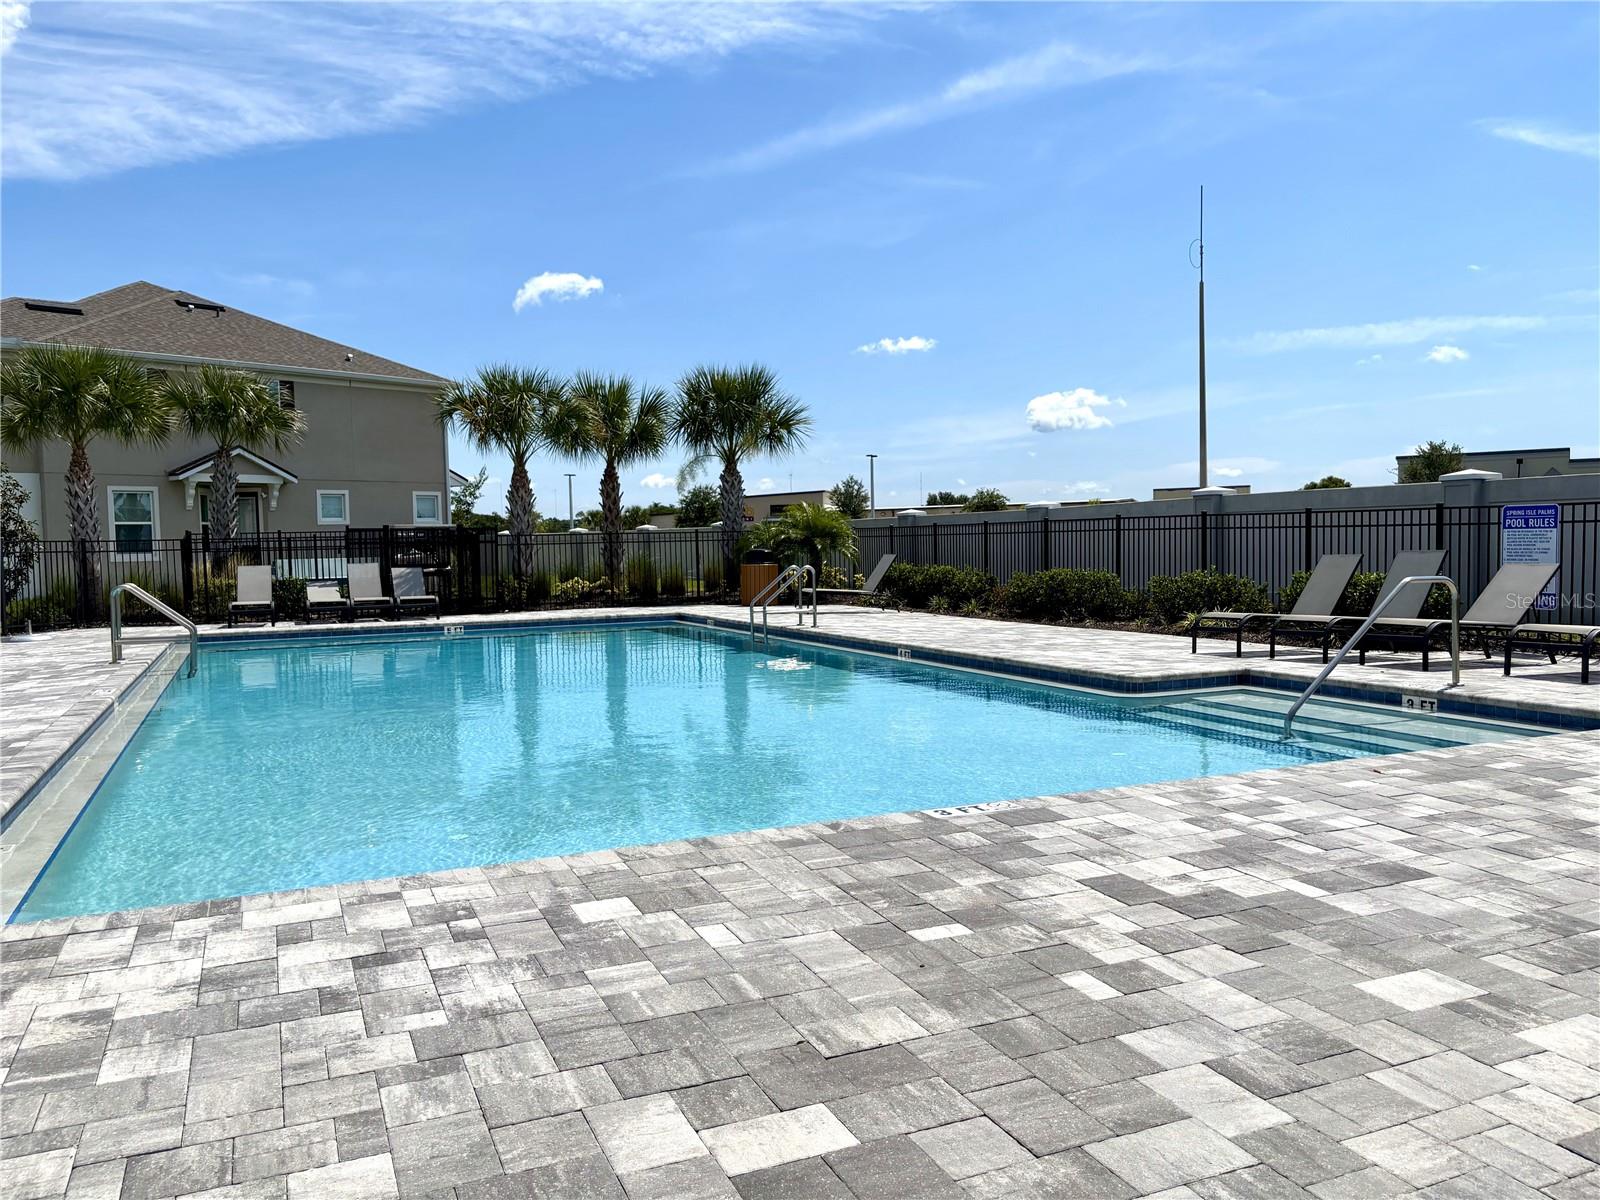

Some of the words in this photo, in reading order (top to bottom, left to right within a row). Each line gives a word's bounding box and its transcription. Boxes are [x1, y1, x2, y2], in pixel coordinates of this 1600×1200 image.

[1505, 518, 1526, 528] POOL
[1528, 518, 1554, 527] RULES
[1407, 699, 1414, 709] 3
[1420, 700, 1436, 710] FT
[955, 805, 986, 813] FT
